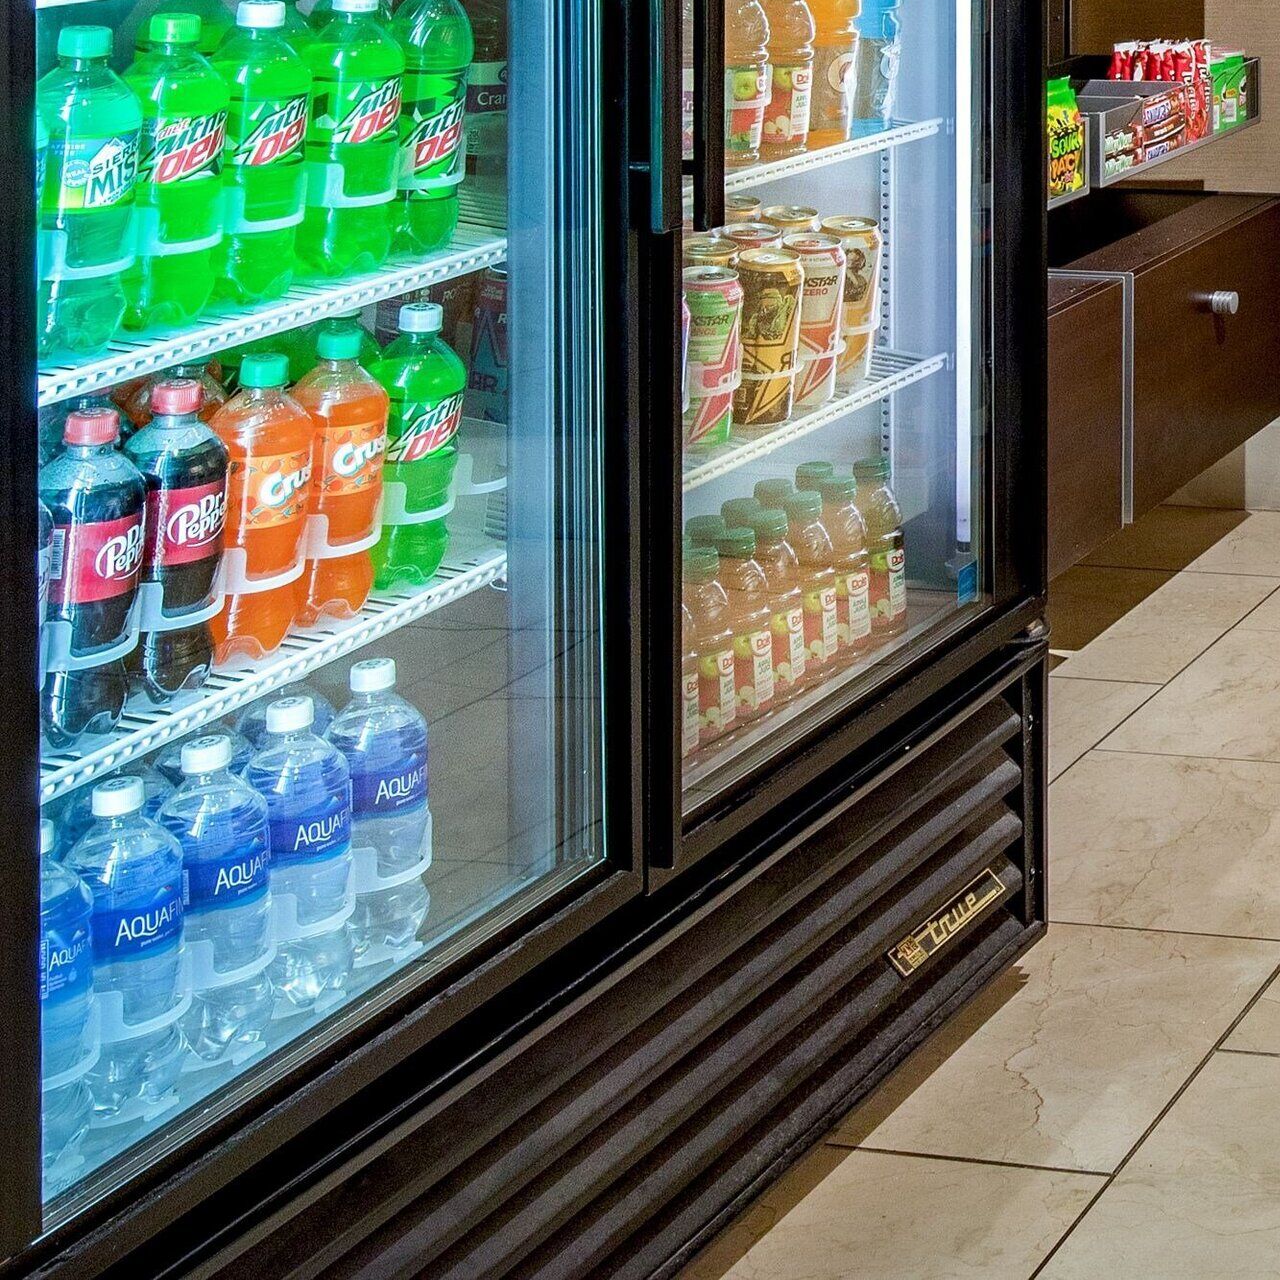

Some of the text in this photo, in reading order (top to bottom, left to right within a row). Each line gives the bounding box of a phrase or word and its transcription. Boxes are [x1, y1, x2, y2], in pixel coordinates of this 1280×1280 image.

[477, 91, 507, 107] Cran
[90, 153, 136, 204] MIS
[332, 435, 385, 476] Crus
[905, 888, 998, 952] true
